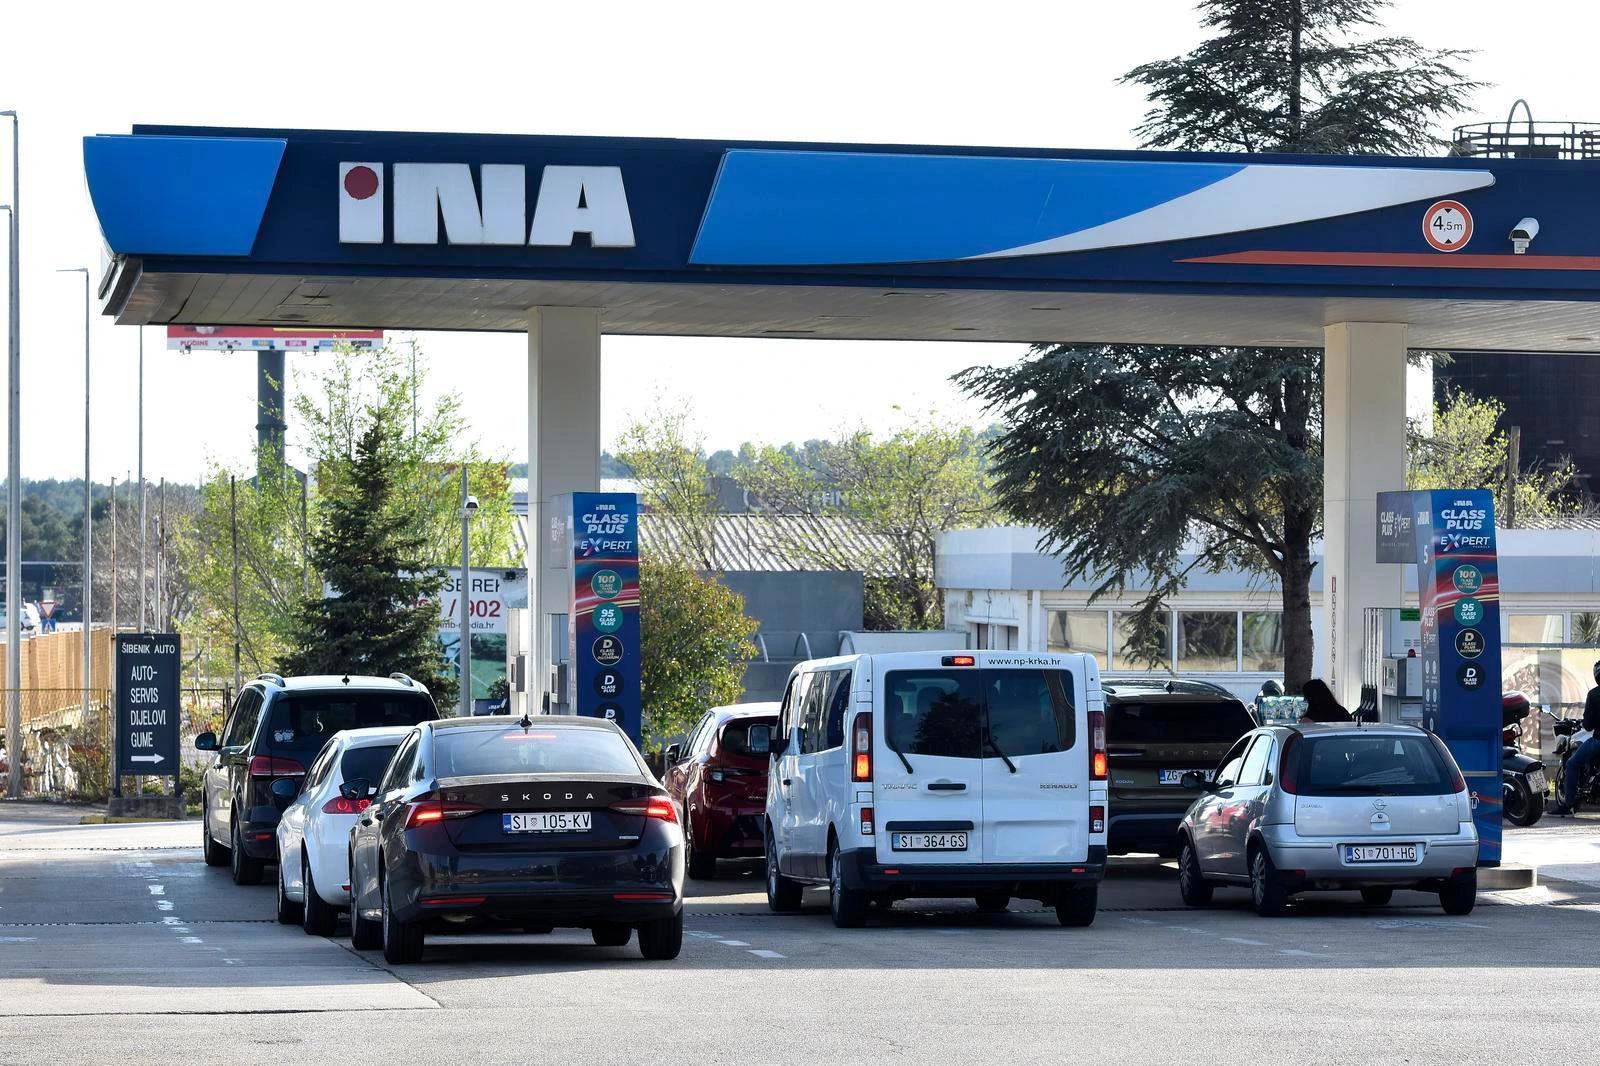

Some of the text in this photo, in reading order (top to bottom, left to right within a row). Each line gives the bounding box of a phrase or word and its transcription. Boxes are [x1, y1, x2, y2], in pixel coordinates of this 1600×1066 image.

[582, 513, 629, 524] CLASS
[1381, 511, 1394, 524] CLASS
[1441, 509, 1486, 520] CLASS
[587, 524, 625, 534] PLUS
[1382, 524, 1393, 536] PLUS
[1446, 520, 1482, 530] PLUS
[597, 575, 616, 584] 100
[1459, 570, 1476, 578] 100
[601, 608, 615, 618] 95
[1462, 603, 1475, 612] 95
[1464, 632, 1475, 642] D
[121, 642, 176, 654] ŠIBENIK AUTO
[602, 639, 613, 649] D
[988, 657, 1062, 666] www.np-krka.hr
[131, 665, 158, 681] AUTO-
[1466, 667, 1477, 678] D
[604, 674, 615, 685] D
[130, 687, 159, 704] SERVIS
[130, 709, 167, 726] DIJELOVI
[605, 708, 616, 719] D
[131, 731, 153, 748] GUME
[1166, 770, 1178, 781] ZG
[501, 792, 594, 802] SKODA
[513, 814, 590, 829] SI 105-KV
[901, 835, 965, 848] SI 364-GS
[1354, 847, 1415, 860] SI 701-HG
